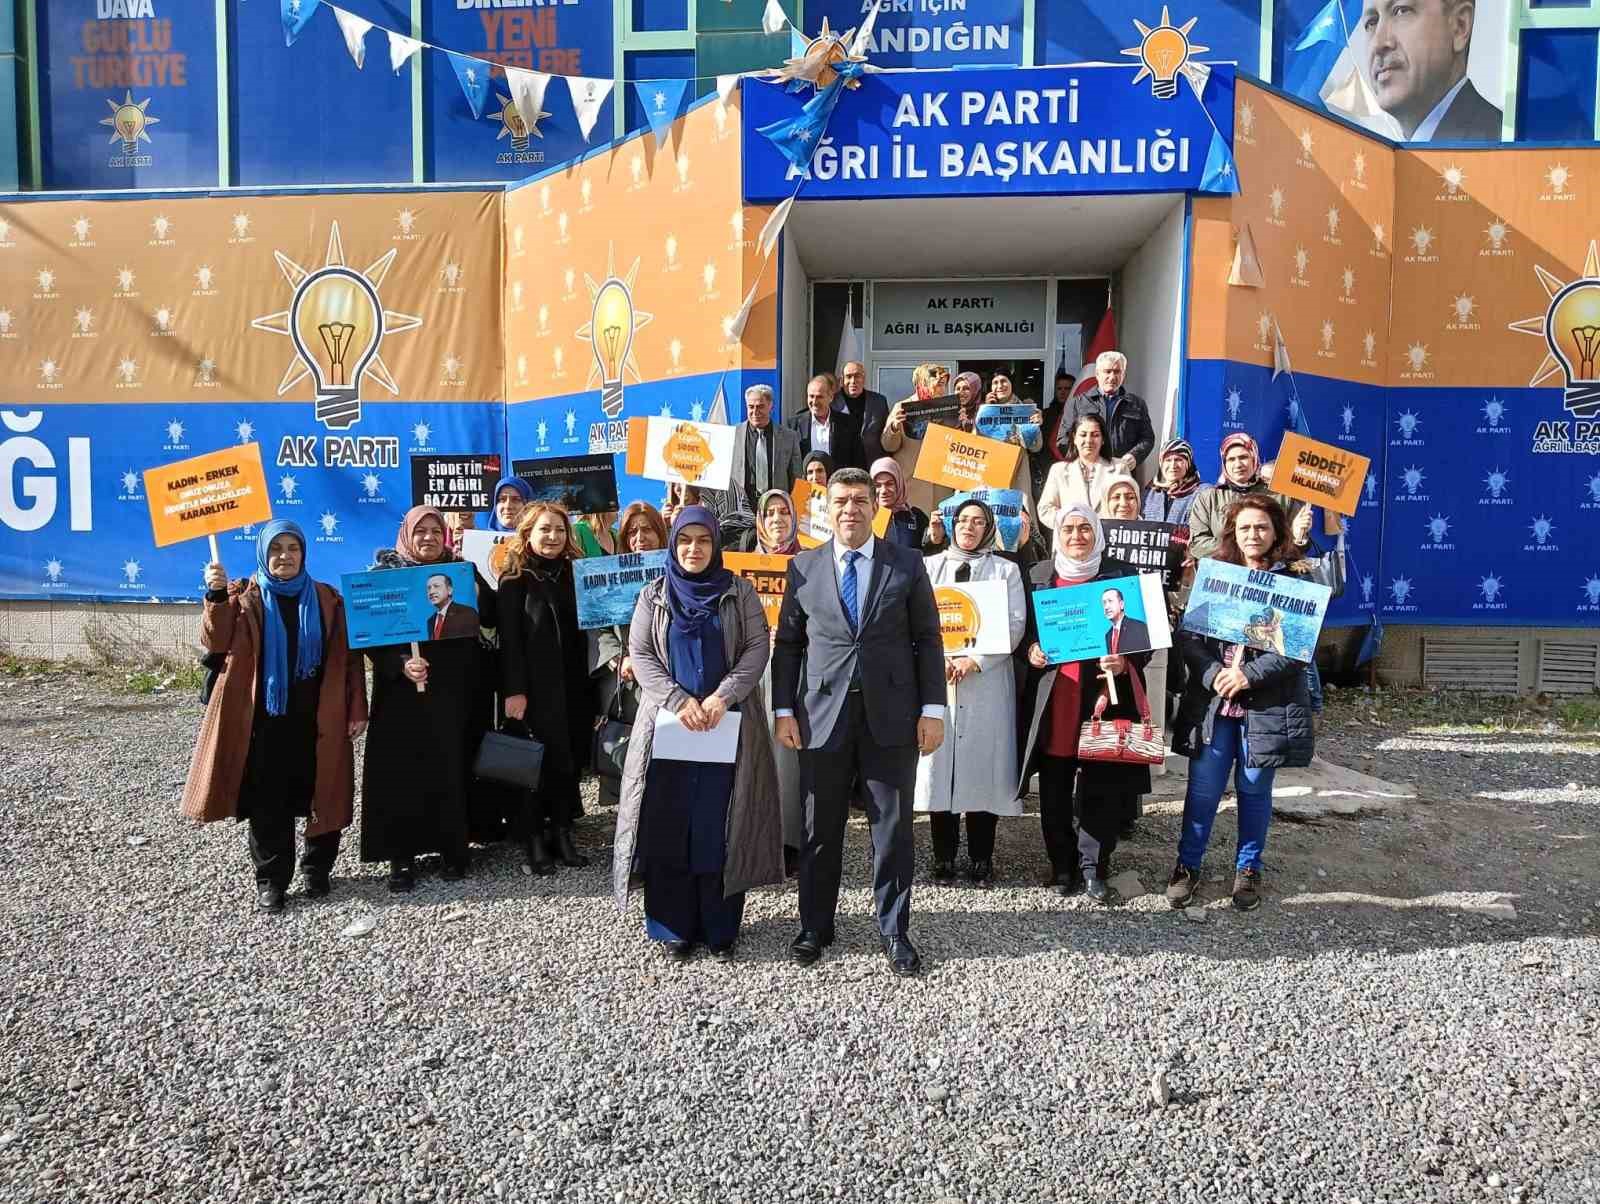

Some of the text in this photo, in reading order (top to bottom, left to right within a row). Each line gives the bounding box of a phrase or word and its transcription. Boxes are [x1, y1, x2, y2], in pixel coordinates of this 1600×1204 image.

[892, 78, 1079, 128] AK PARTİ
[892, 134, 928, 178] İL
[940, 128, 1190, 182] BAŞKANLIĞI
[928, 298, 948, 309] AK
[885, 321, 919, 335] AĞRI
[944, 319, 1035, 336] BAŞKANLIĞI
[589, 422, 607, 441] AK
[1533, 420, 1570, 441] AK
[277, 435, 318, 467] AK
[950, 441, 989, 460] ŞİDDET
[428, 460, 483, 478] ŞİDDETİN
[1297, 450, 1346, 476] ŞİDDET
[167, 475, 198, 492] KADIN
[206, 465, 240, 481] ERKEK
[449, 475, 482, 491] AĞIRI
[180, 500, 239, 522] KARARLIYIZ.
[423, 493, 489, 508] GAZZE'DE
[1109, 526, 1170, 548] ŞİDDETİN
[1129, 546, 1167, 567] AĞIRI
[583, 573, 607, 590] KADIN
[608, 572, 618, 586] VE
[1202, 576, 1229, 595] KADIN
[1230, 583, 1243, 598] VE
[1270, 594, 1318, 616] MEZARLIĞI
